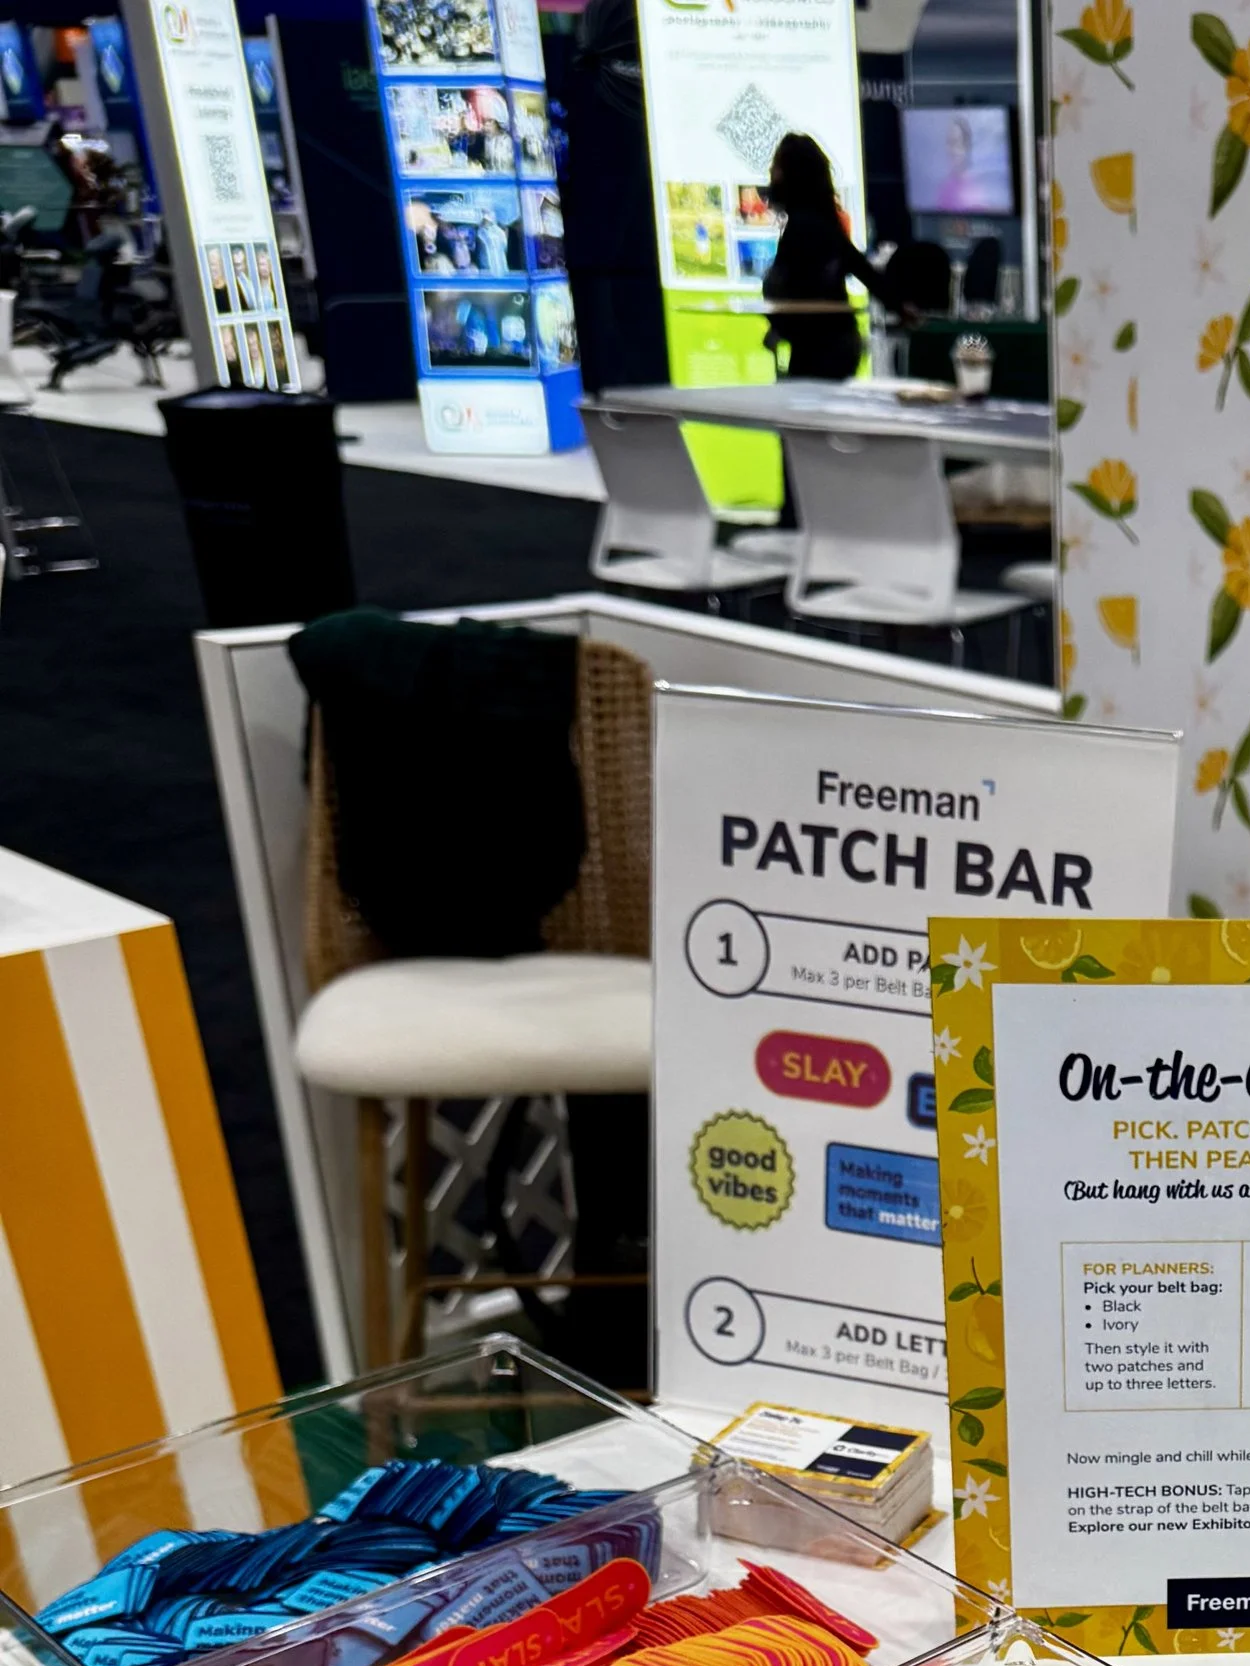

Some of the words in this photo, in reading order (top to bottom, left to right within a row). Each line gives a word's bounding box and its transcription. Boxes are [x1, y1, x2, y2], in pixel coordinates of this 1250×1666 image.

[818, 769, 980, 822] Freeman
[721, 814, 928, 890] PATCH
[954, 840, 1093, 911] BAR
[716, 932, 738, 966] 1
[842, 942, 898, 968] ADD
[791, 966, 825, 985] Max
[829, 970, 840, 986] 3
[843, 975, 870, 993] per
[876, 977, 906, 997] Belt
[782, 1051, 868, 1088] SLAY
[1112, 1120, 1179, 1139] PICK.
[708, 1146, 776, 1174] good
[1129, 1150, 1197, 1169] THEN
[839, 1160, 904, 1188] Making
[707, 1173, 777, 1204] vibes
[838, 1183, 920, 1209] moments
[1064, 1180, 1109, 1201] (But
[1113, 1179, 1160, 1204] hang
[1166, 1179, 1208, 1199] with
[1211, 1184, 1233, 1199] us
[838, 1201, 873, 1221] that
[878, 1209, 940, 1232] matter
[1083, 1263, 1116, 1276] FOR
[1121, 1262, 1215, 1275] PLANNERS:
[1083, 1281, 1115, 1294] Pick
[1119, 1284, 1153, 1296] your
[1157, 1281, 1186, 1293] belt
[1190, 1281, 1223, 1295] bag:
[1102, 1300, 1142, 1313] Black
[713, 1306, 735, 1337] 2
[1102, 1319, 1139, 1333] Ivory
[836, 1322, 887, 1347] ADD
[785, 1340, 817, 1357] Max
[821, 1345, 832, 1361] 3
[835, 1349, 860, 1367] per
[863, 1352, 894, 1371] Belt
[899, 1358, 929, 1380] Bag
[1085, 1342, 1121, 1355] Then
[1125, 1342, 1160, 1356] style
[1164, 1341, 1174, 1354] it
[1177, 1341, 1210, 1353] with
[1085, 1362, 1114, 1373] two
[1117, 1360, 1173, 1374] patches
[1177, 1359, 1204, 1371] and
[1085, 1380, 1103, 1392] up
[1108, 1379, 1122, 1390] to
[1126, 1378, 1163, 1390] three
[1167, 1377, 1216, 1389] letters.
[1067, 1453, 1100, 1464] Now
[1105, 1452, 1152, 1466] mingle
[1156, 1451, 1182, 1463] and
[1186, 1450, 1213, 1462] chill
[1068, 1486, 1157, 1499] HIGH-TECH
[1161, 1485, 1223, 1497] BONUS:
[1068, 1506, 1085, 1516] on
[1090, 1504, 1113, 1515] the
[1116, 1504, 1153, 1517] strap
[1157, 1502, 1172, 1514] of
[1175, 1502, 1198, 1514] the
[1202, 1502, 1229, 1513] belt
[1068, 1521, 1125, 1534] Explore
[1128, 1522, 1154, 1531] our
[1157, 1521, 1188, 1531] new
